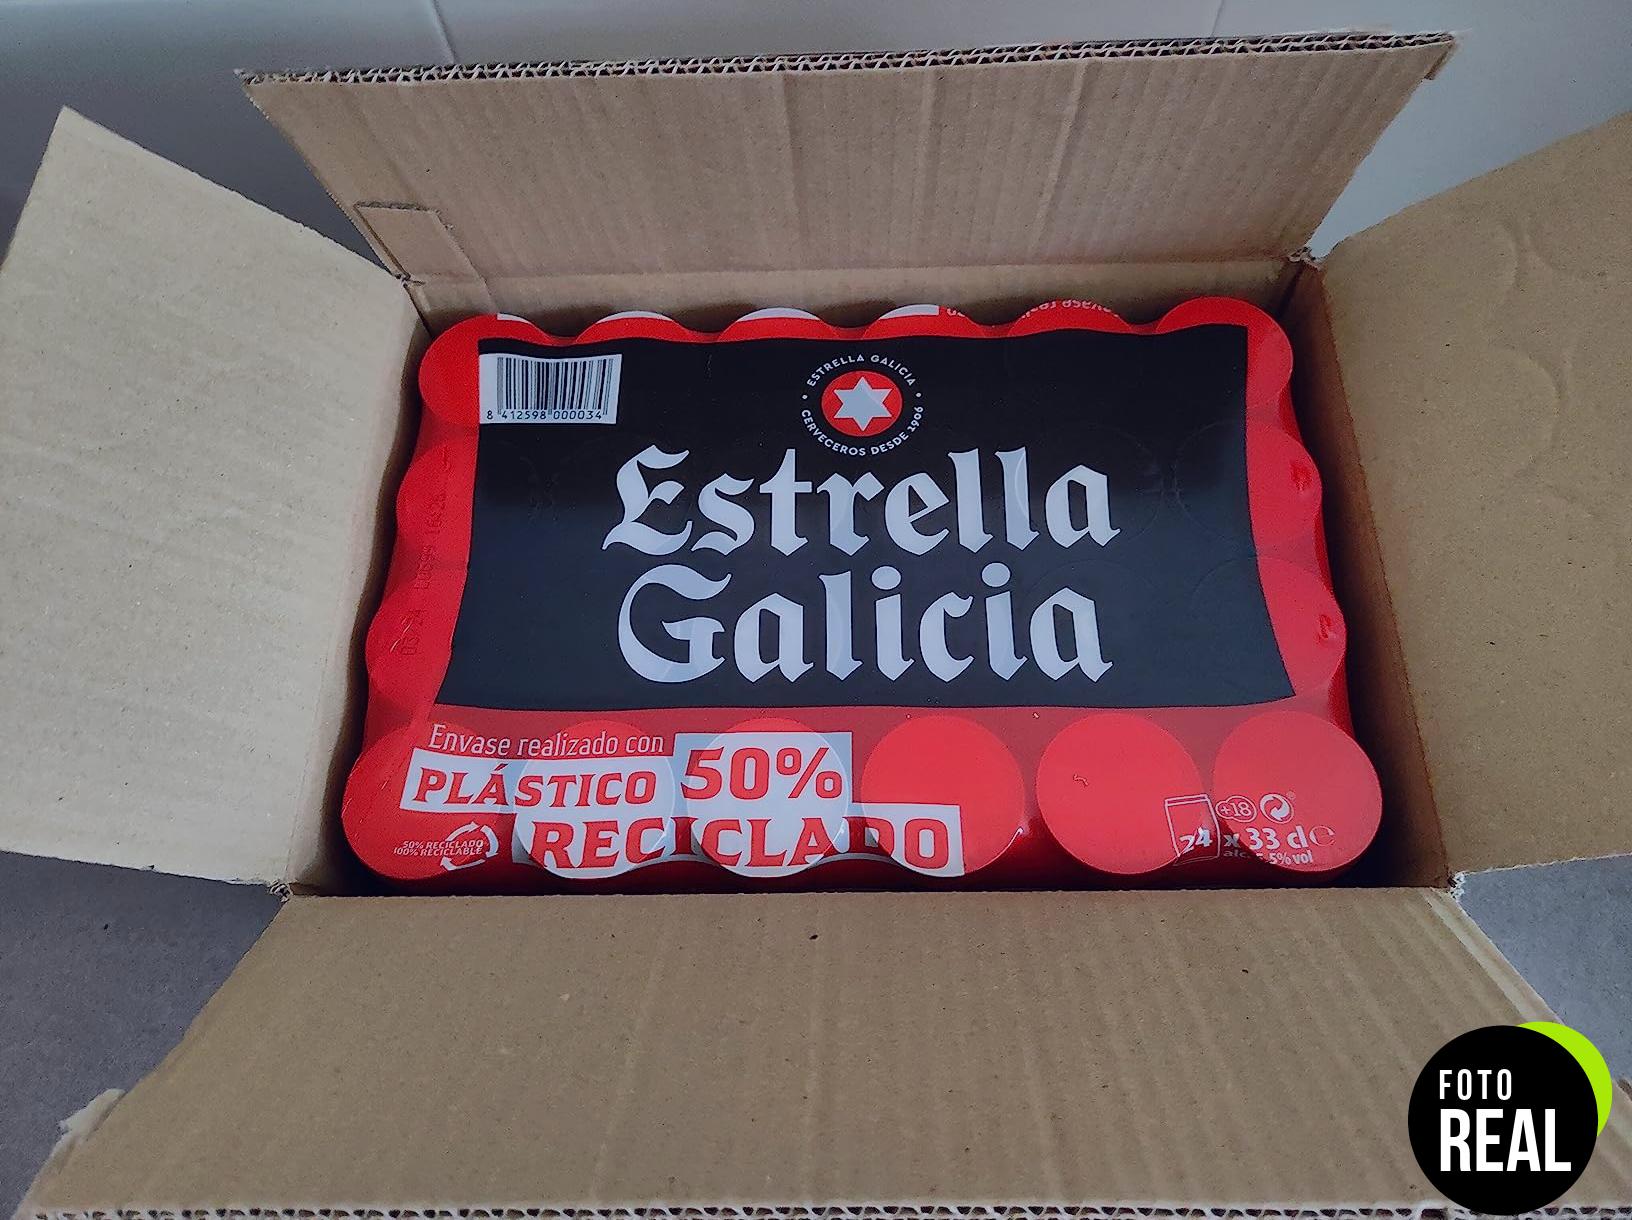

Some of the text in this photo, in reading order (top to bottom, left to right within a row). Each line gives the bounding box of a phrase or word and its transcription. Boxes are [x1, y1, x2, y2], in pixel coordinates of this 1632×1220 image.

[806, 354, 916, 387] ESTRELLA GALICIA
[486, 410, 602, 420] 8 412598 000034
[801, 406, 924, 456] CERVECEROS DESDE 1906
[602, 444, 1121, 556] Estrella
[618, 562, 1113, 683] Galicia
[428, 723, 664, 757] Envase realizado con
[413, 747, 842, 808] PLÁSTICO 50%
[1220, 802, 1252, 817] +18
[393, 847, 483, 856] 100% RECICLABLE
[402, 840, 484, 849] 50% RECICLADO
[531, 815, 949, 869] RECICLADO
[1179, 826, 1213, 854] 24
[1223, 833, 1240, 848] x
[1245, 827, 1280, 850] 33
[1292, 850, 1314, 865] vol
